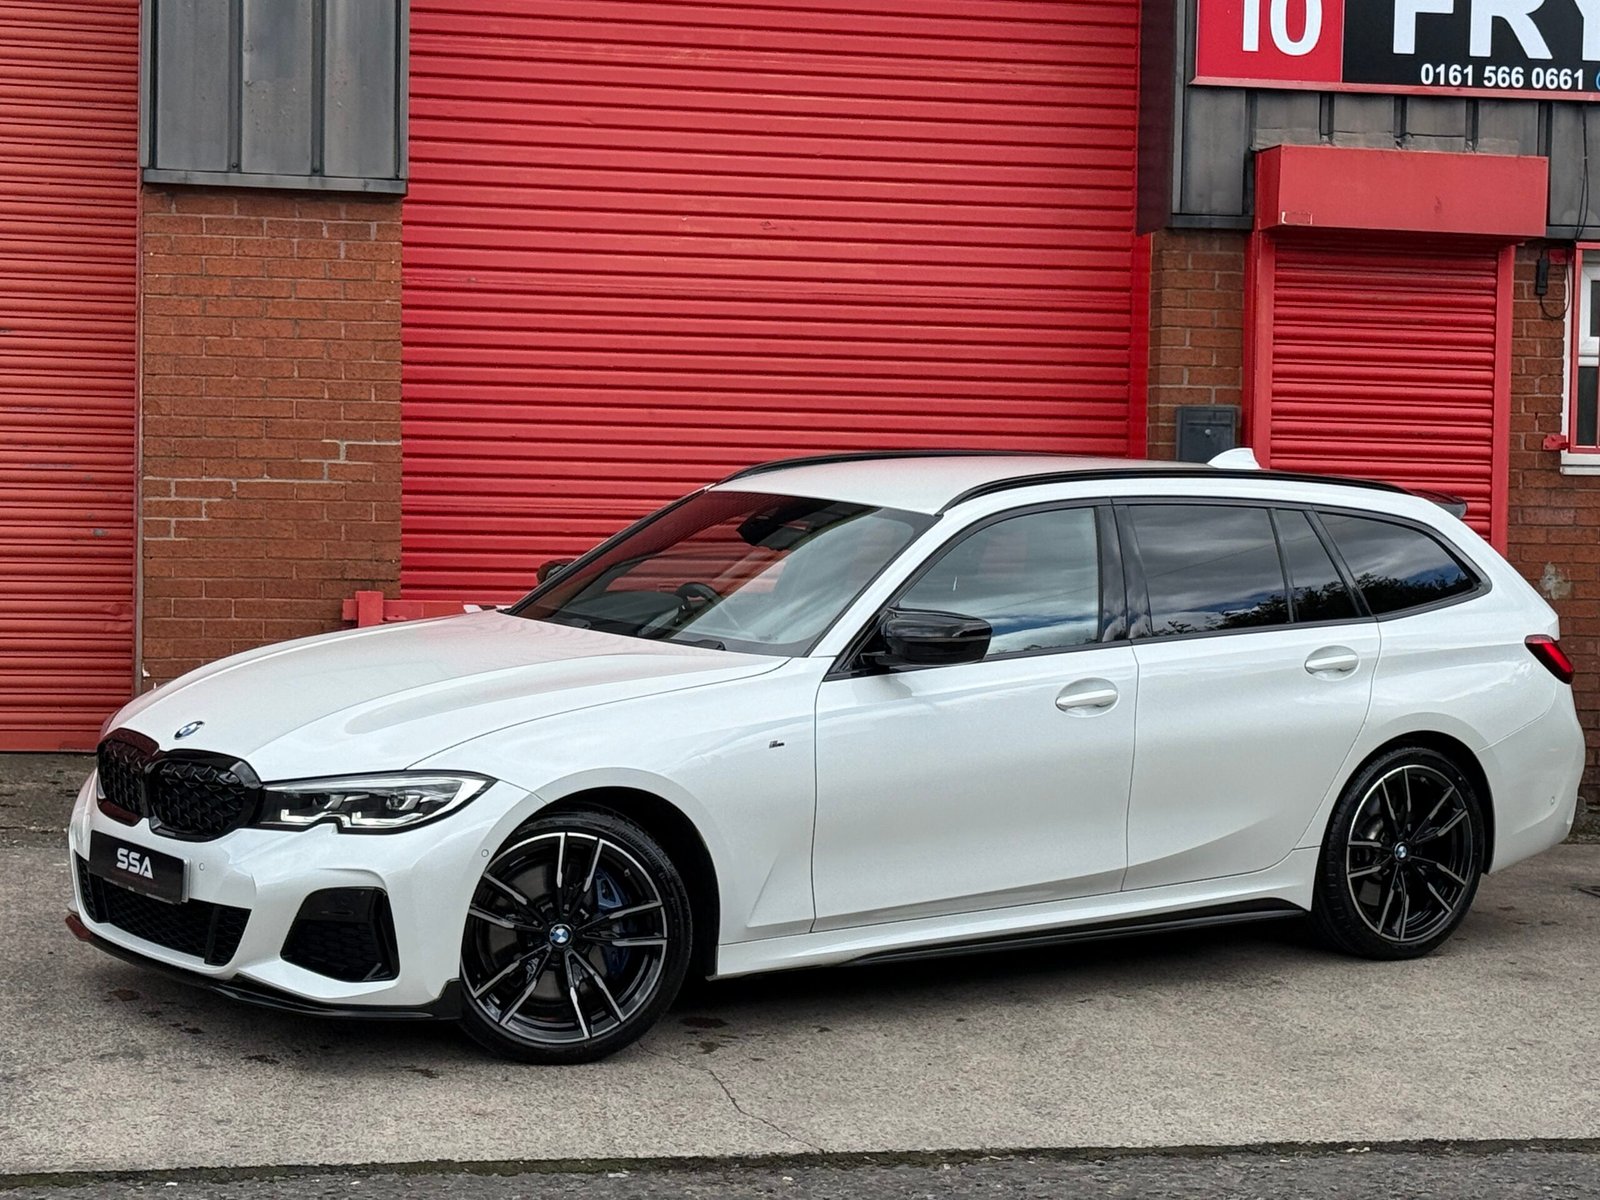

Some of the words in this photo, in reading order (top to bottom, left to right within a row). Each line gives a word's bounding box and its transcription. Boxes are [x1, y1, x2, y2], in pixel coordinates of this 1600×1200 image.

[1242, 0, 1323, 56] 10
[1392, 0, 1600, 62] FR
[1420, 63, 1474, 87] 0161
[1483, 65, 1525, 89] 566
[1531, 67, 1584, 91] 0661
[116, 847, 154, 880] SSA
